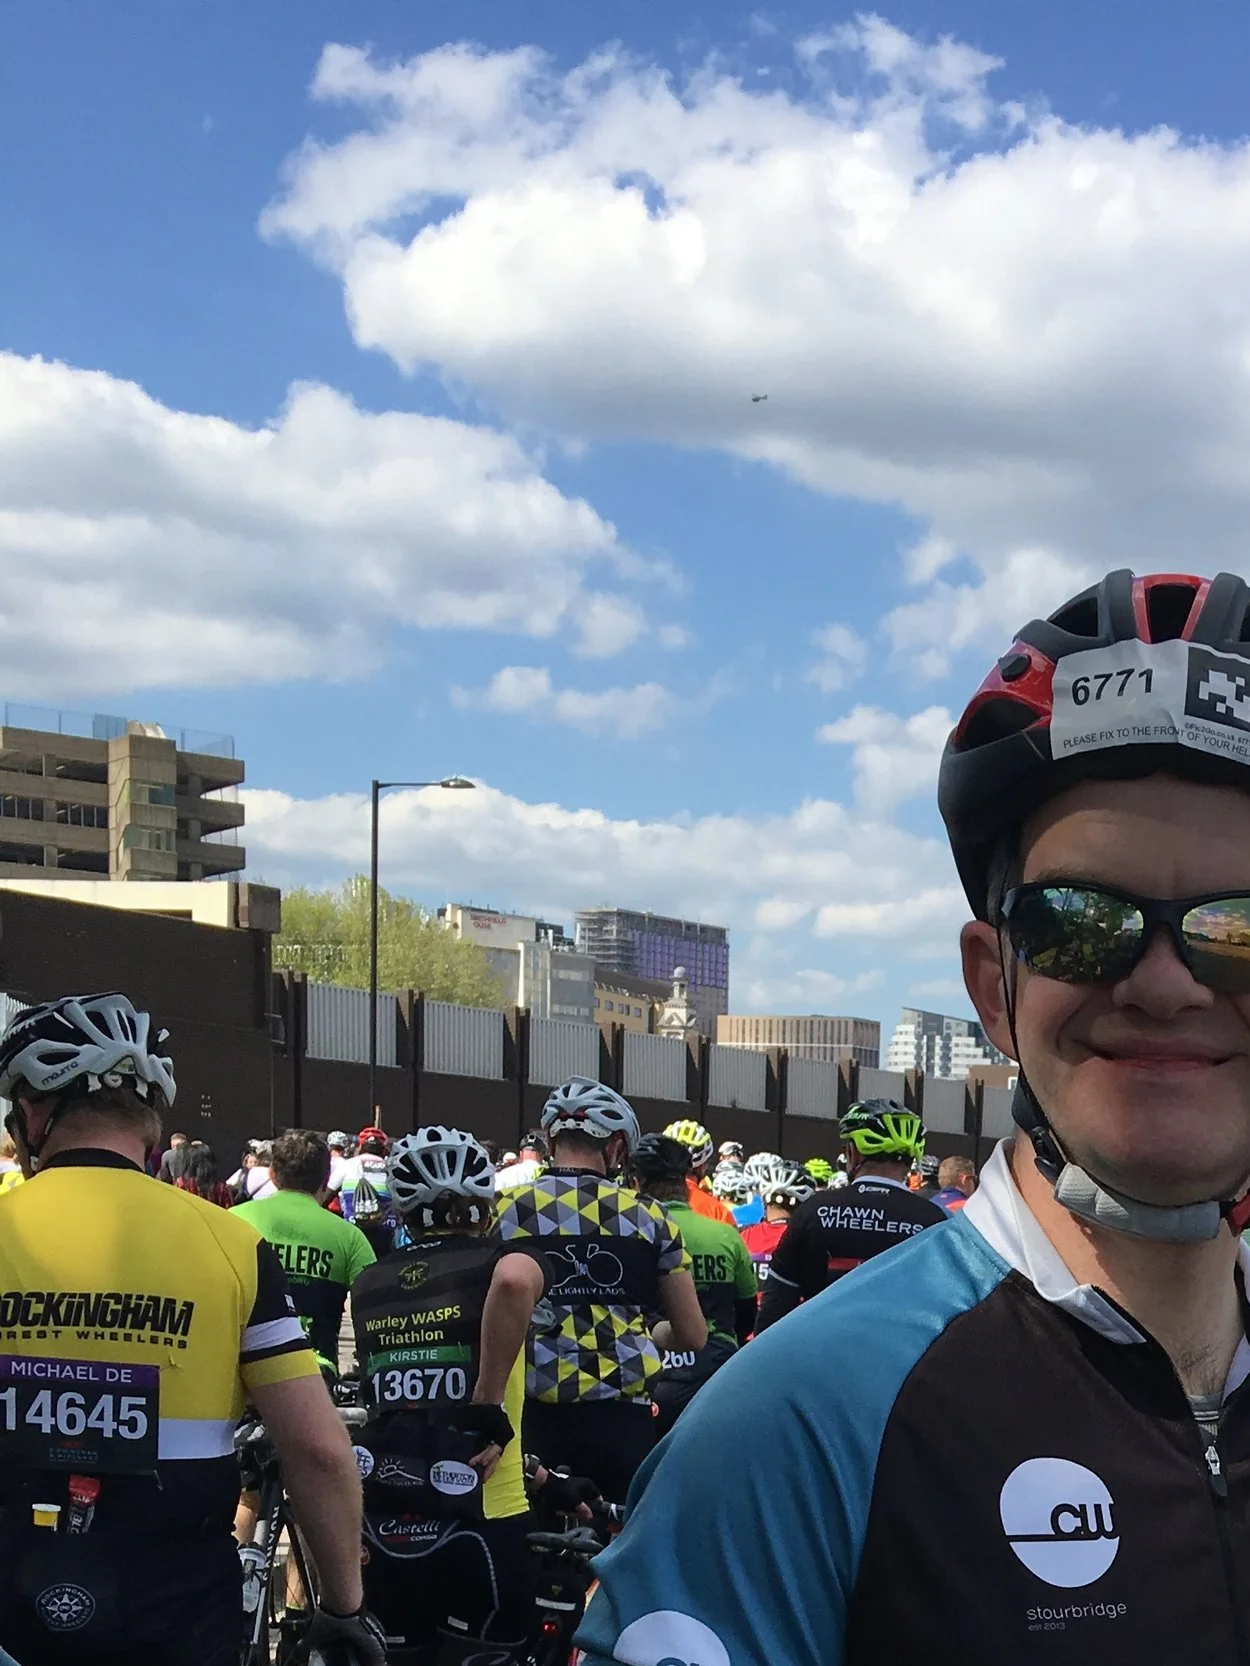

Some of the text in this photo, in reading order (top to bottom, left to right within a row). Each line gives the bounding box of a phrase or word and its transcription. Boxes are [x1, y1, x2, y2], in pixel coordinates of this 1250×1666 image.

[1071, 668, 1154, 706] 6771
[1063, 733, 1097, 749] PLEASE
[1100, 730, 1114, 741] FIX
[1117, 728, 1130, 738] TO
[1131, 726, 1151, 737] THE
[1153, 726, 1185, 738] FRONT
[1187, 731, 1200, 742] OF
[1203, 735, 1230, 751] YOUR
[817, 1206, 884, 1221] CHAWN
[821, 1218, 924, 1236] WHEELERS
[0, 1291, 194, 1337] OCKINGHAM
[366, 1305, 461, 1333] Warley WASPS
[0, 1330, 187, 1349] REST WHEELERS
[378, 1329, 444, 1346] Triathlon
[389, 1349, 438, 1363] KIRSTIE
[11, 1361, 132, 1383] MICHAEL DE
[372, 1367, 467, 1404] 13670
[0, 1387, 148, 1440] 14645
[1026, 1602, 1128, 1620] stourbridge
[1028, 1622, 1066, 1631] est 2013
